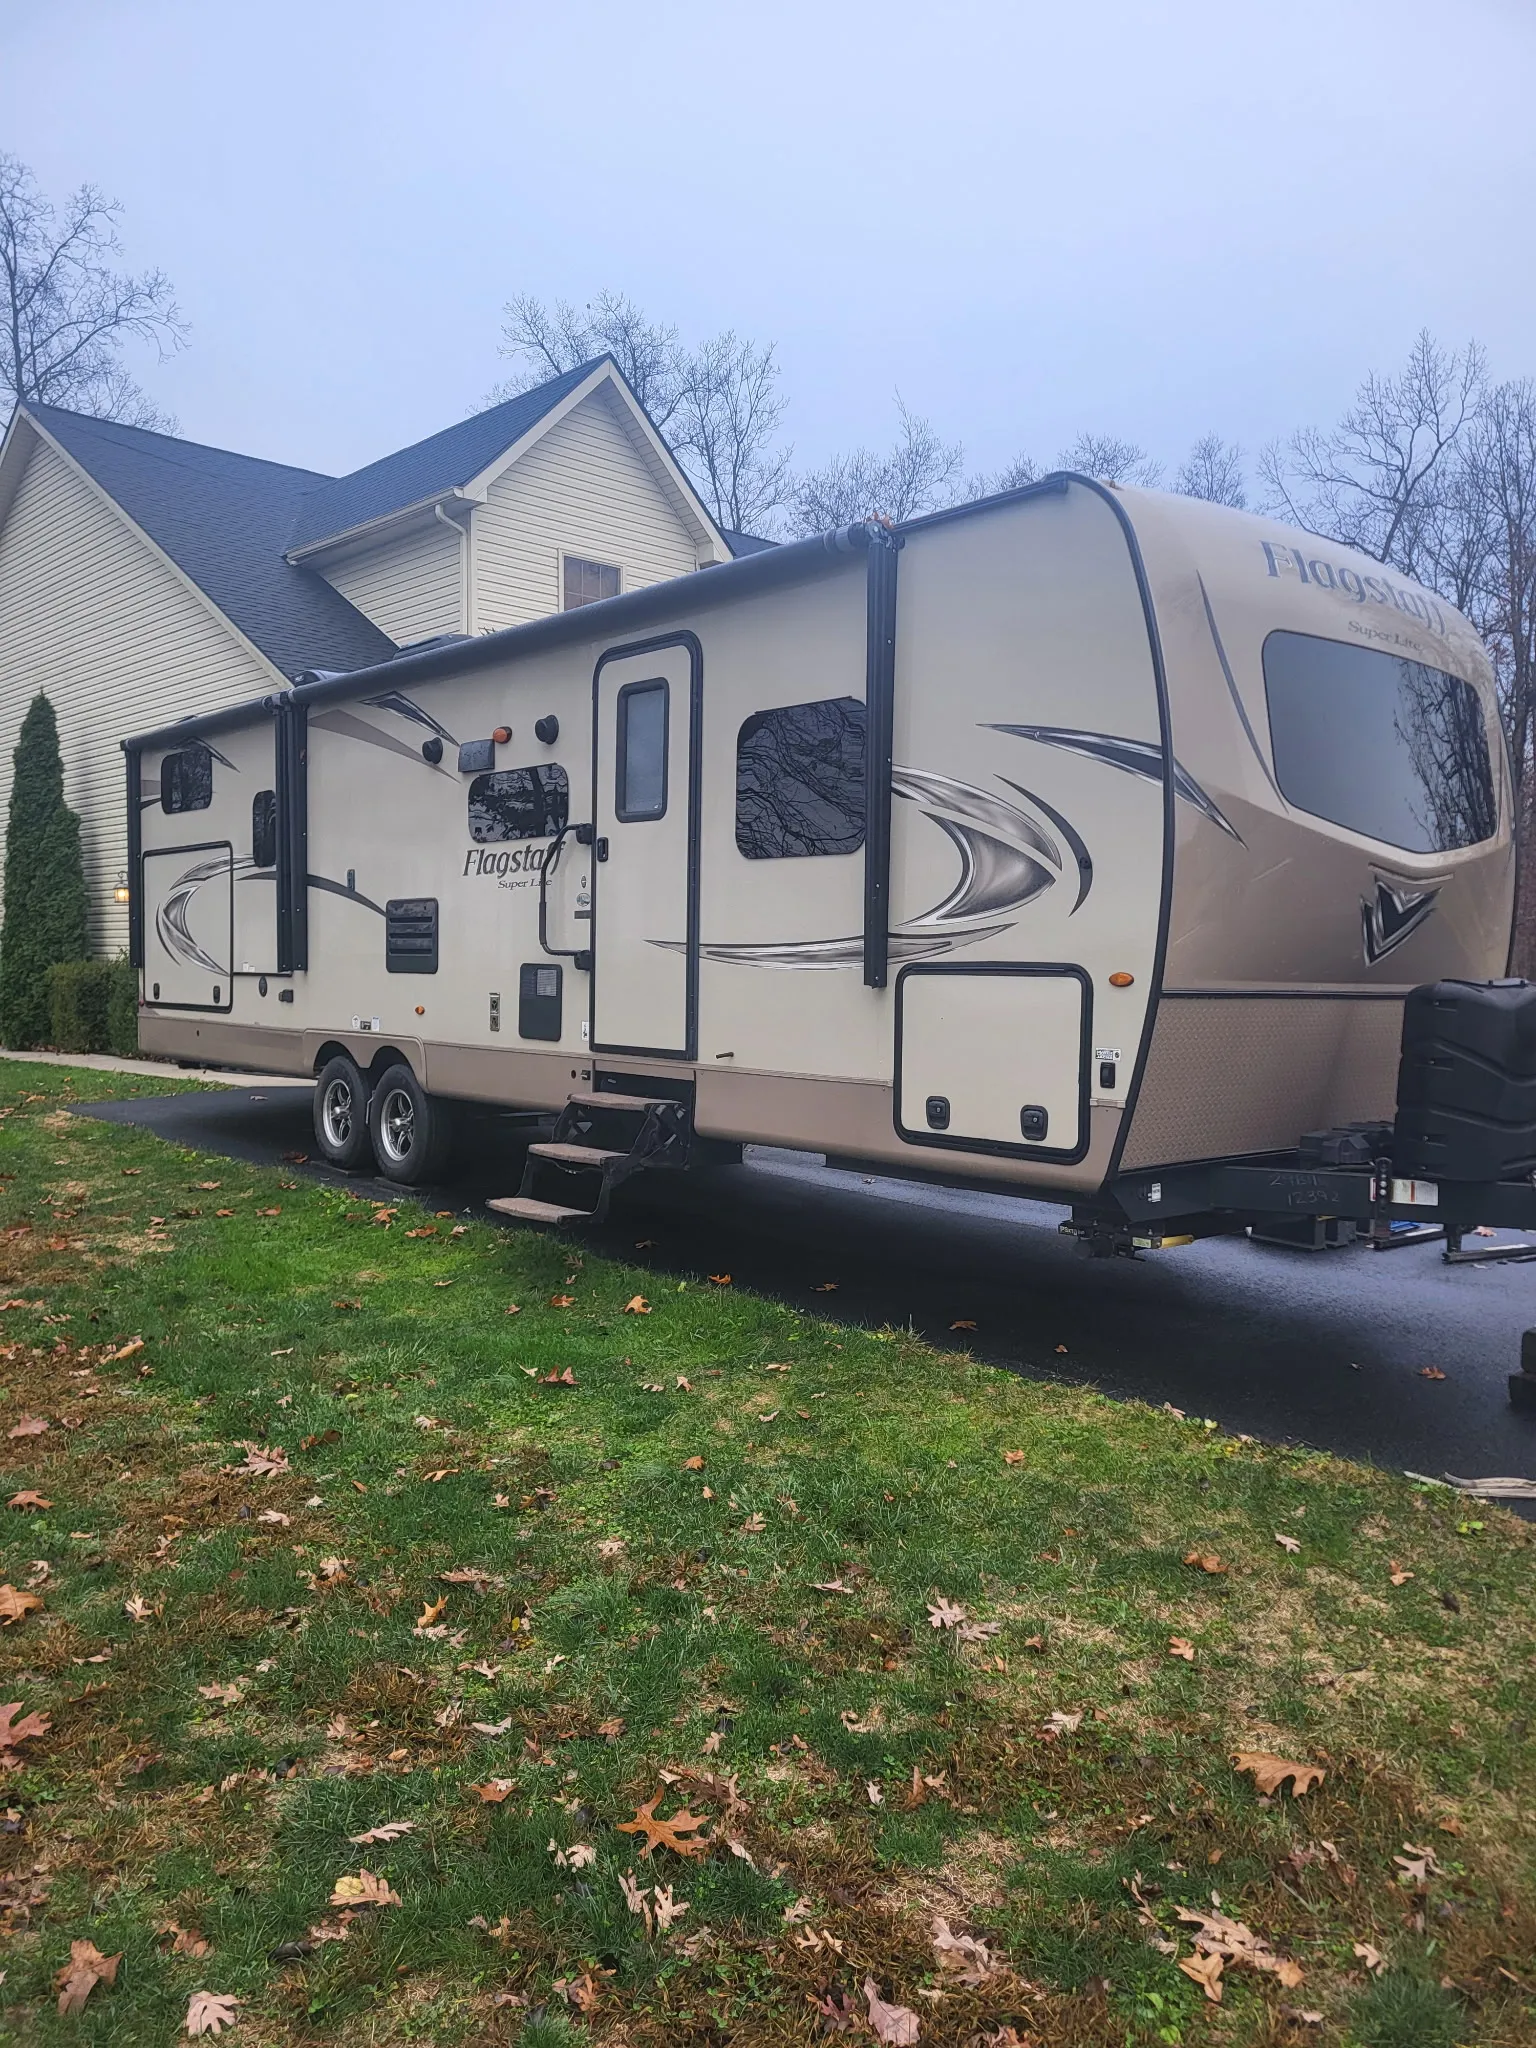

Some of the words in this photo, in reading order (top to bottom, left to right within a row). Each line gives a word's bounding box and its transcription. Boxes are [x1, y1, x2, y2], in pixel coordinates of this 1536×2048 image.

[1259, 540, 1446, 635] Flagstaff
[1348, 621, 1392, 640] Super
[498, 879, 529, 890] Super
[530, 878, 552, 887] Lie
